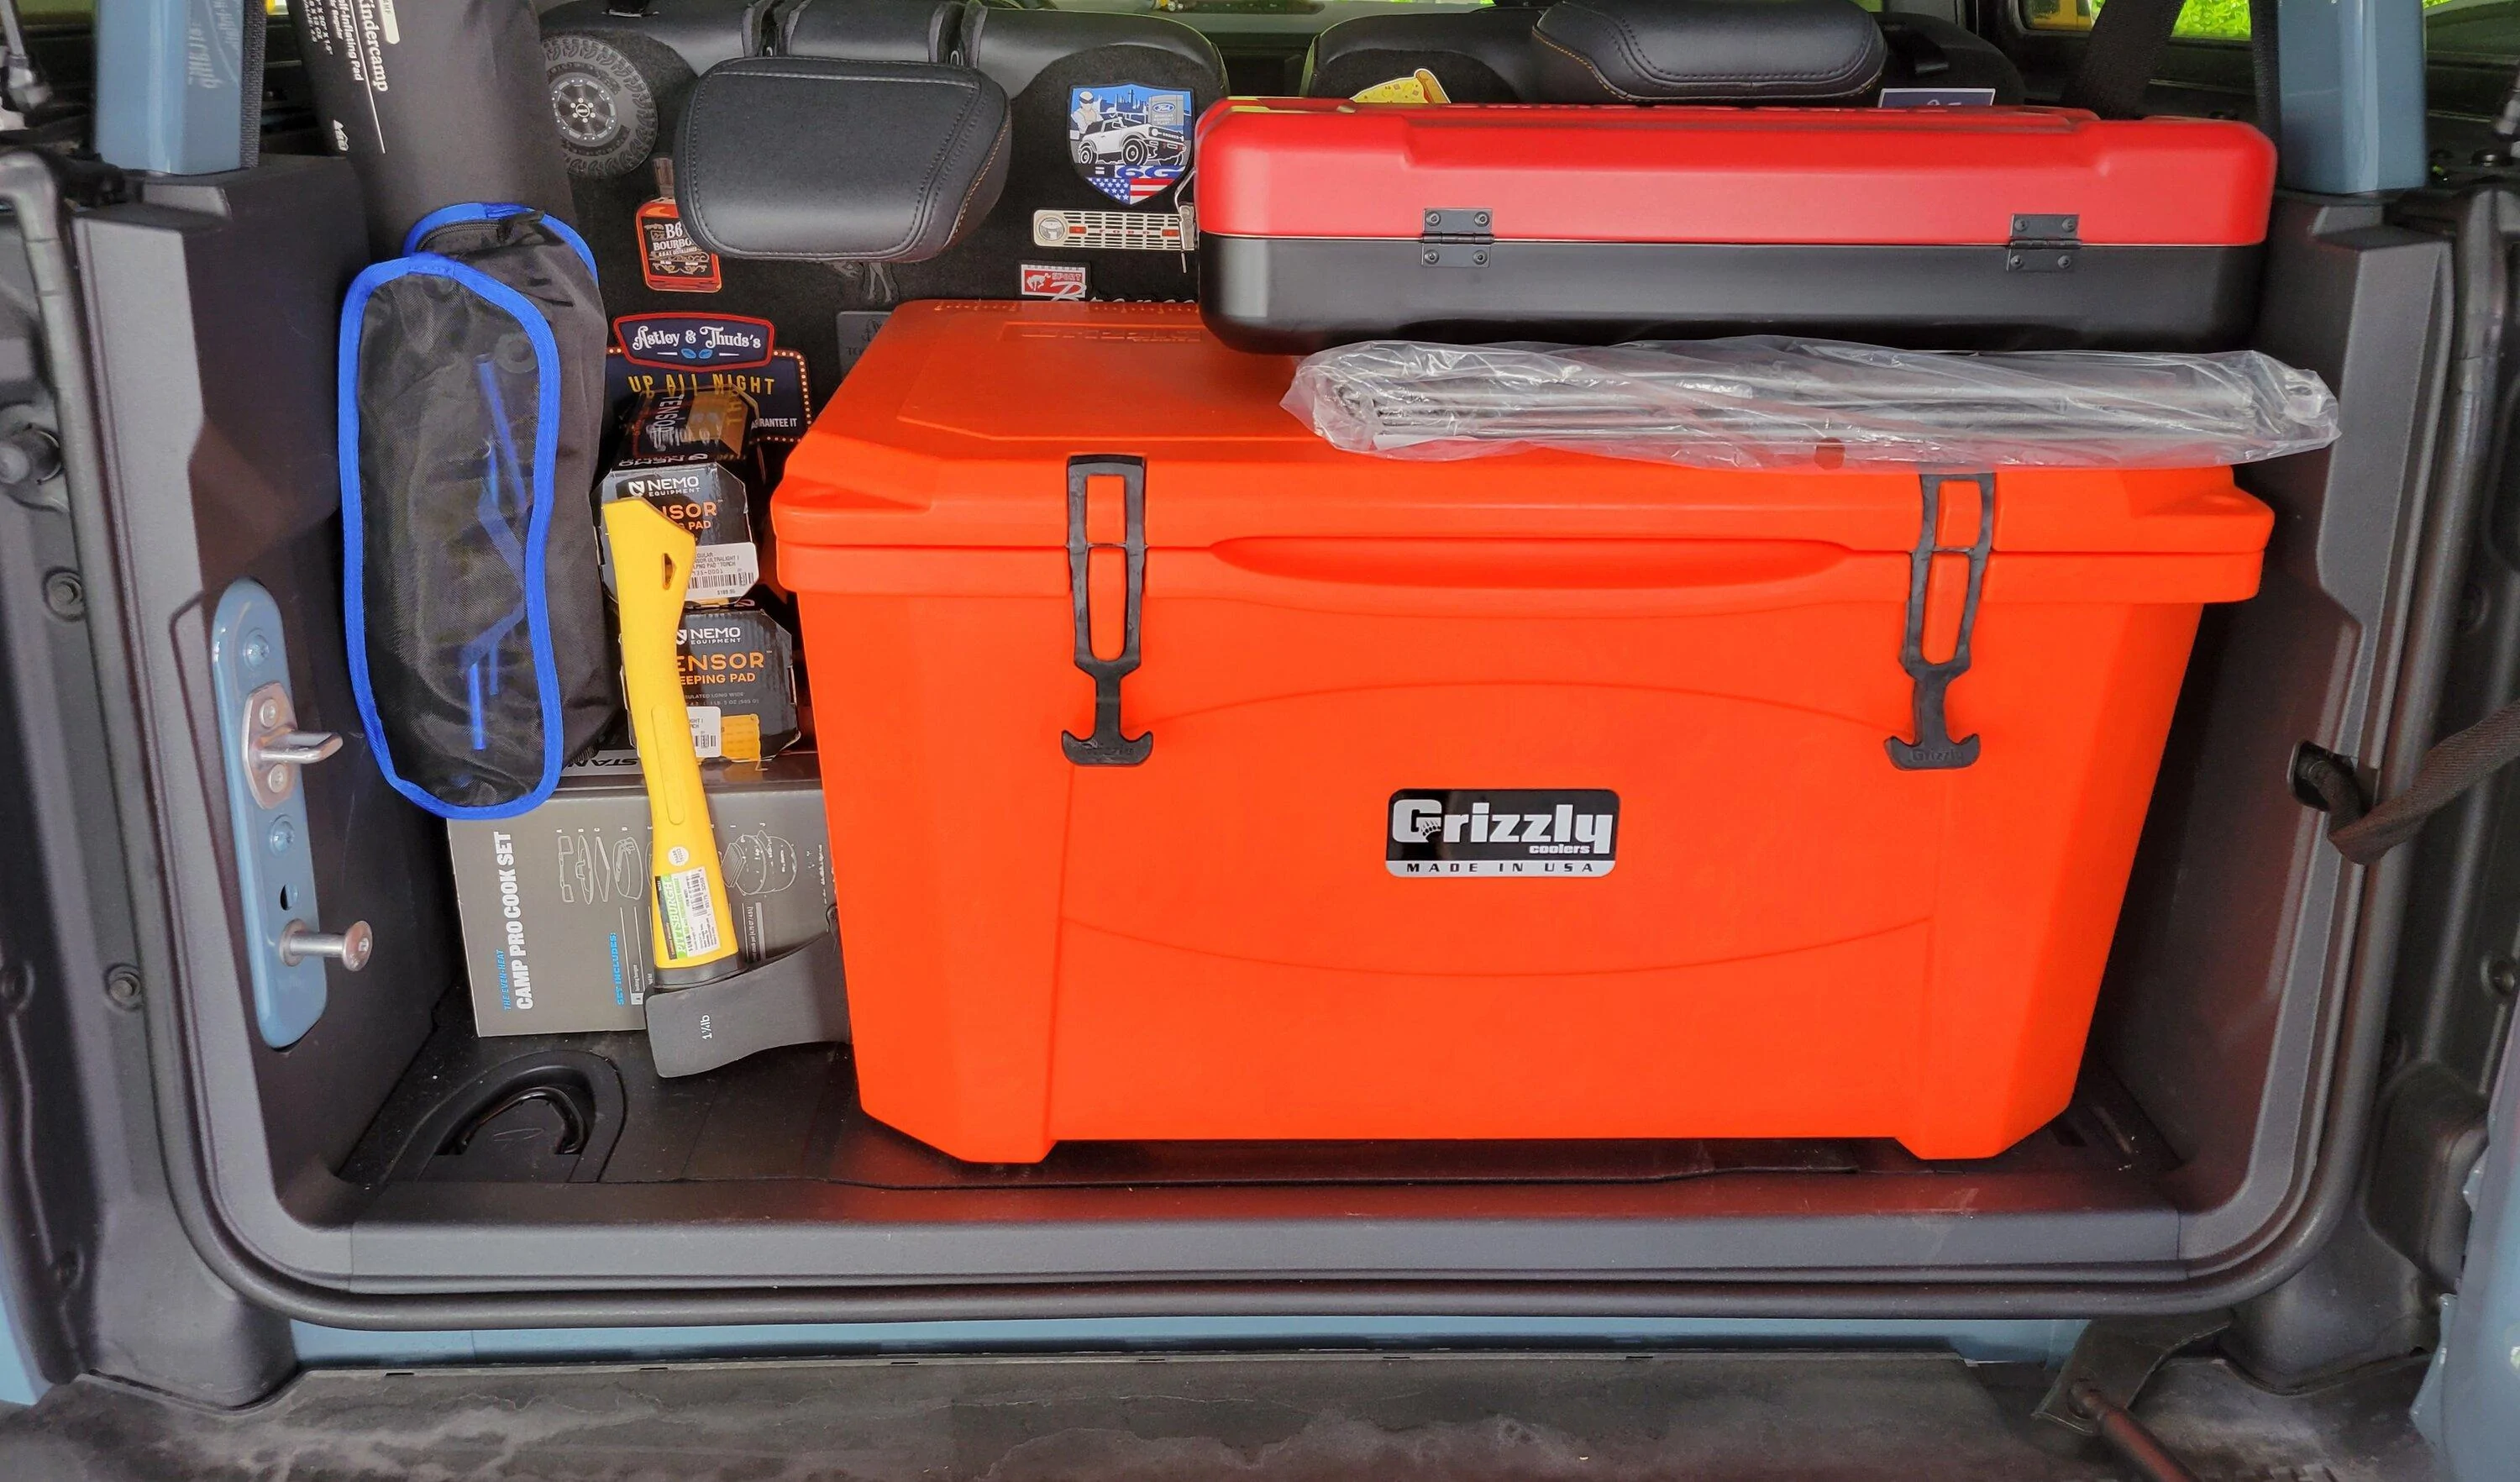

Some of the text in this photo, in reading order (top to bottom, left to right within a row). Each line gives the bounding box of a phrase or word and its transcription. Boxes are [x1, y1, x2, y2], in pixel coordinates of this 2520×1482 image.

[338, 0, 365, 81] elf-Inflating Pad
[664, 221, 683, 239] B6
[653, 238, 695, 251] BOURBO
[1052, 271, 1082, 281] SPORT
[633, 325, 761, 350] Astley & Thuds's
[628, 375, 654, 392] UP
[712, 373, 774, 396] NIGHT
[790, 418, 798, 428] IT
[647, 476, 700, 491] NEMO
[648, 487, 701, 497] EQUIPMENT
[661, 502, 717, 520] SOR
[689, 520, 711, 530] PAD
[690, 627, 741, 639] NEMO
[677, 652, 764, 672] ENSOR
[680, 672, 756, 686] EEPING PAD
[568, 758, 638, 768] STAN
[1393, 798, 1614, 854] Grizzly
[1529, 843, 1590, 854] coolers
[1406, 863, 1593, 873] MADE IN USA
[494, 831, 533, 1010] CAMP PRO COOK SET
[664, 880, 686, 953] PITTSBURGH
